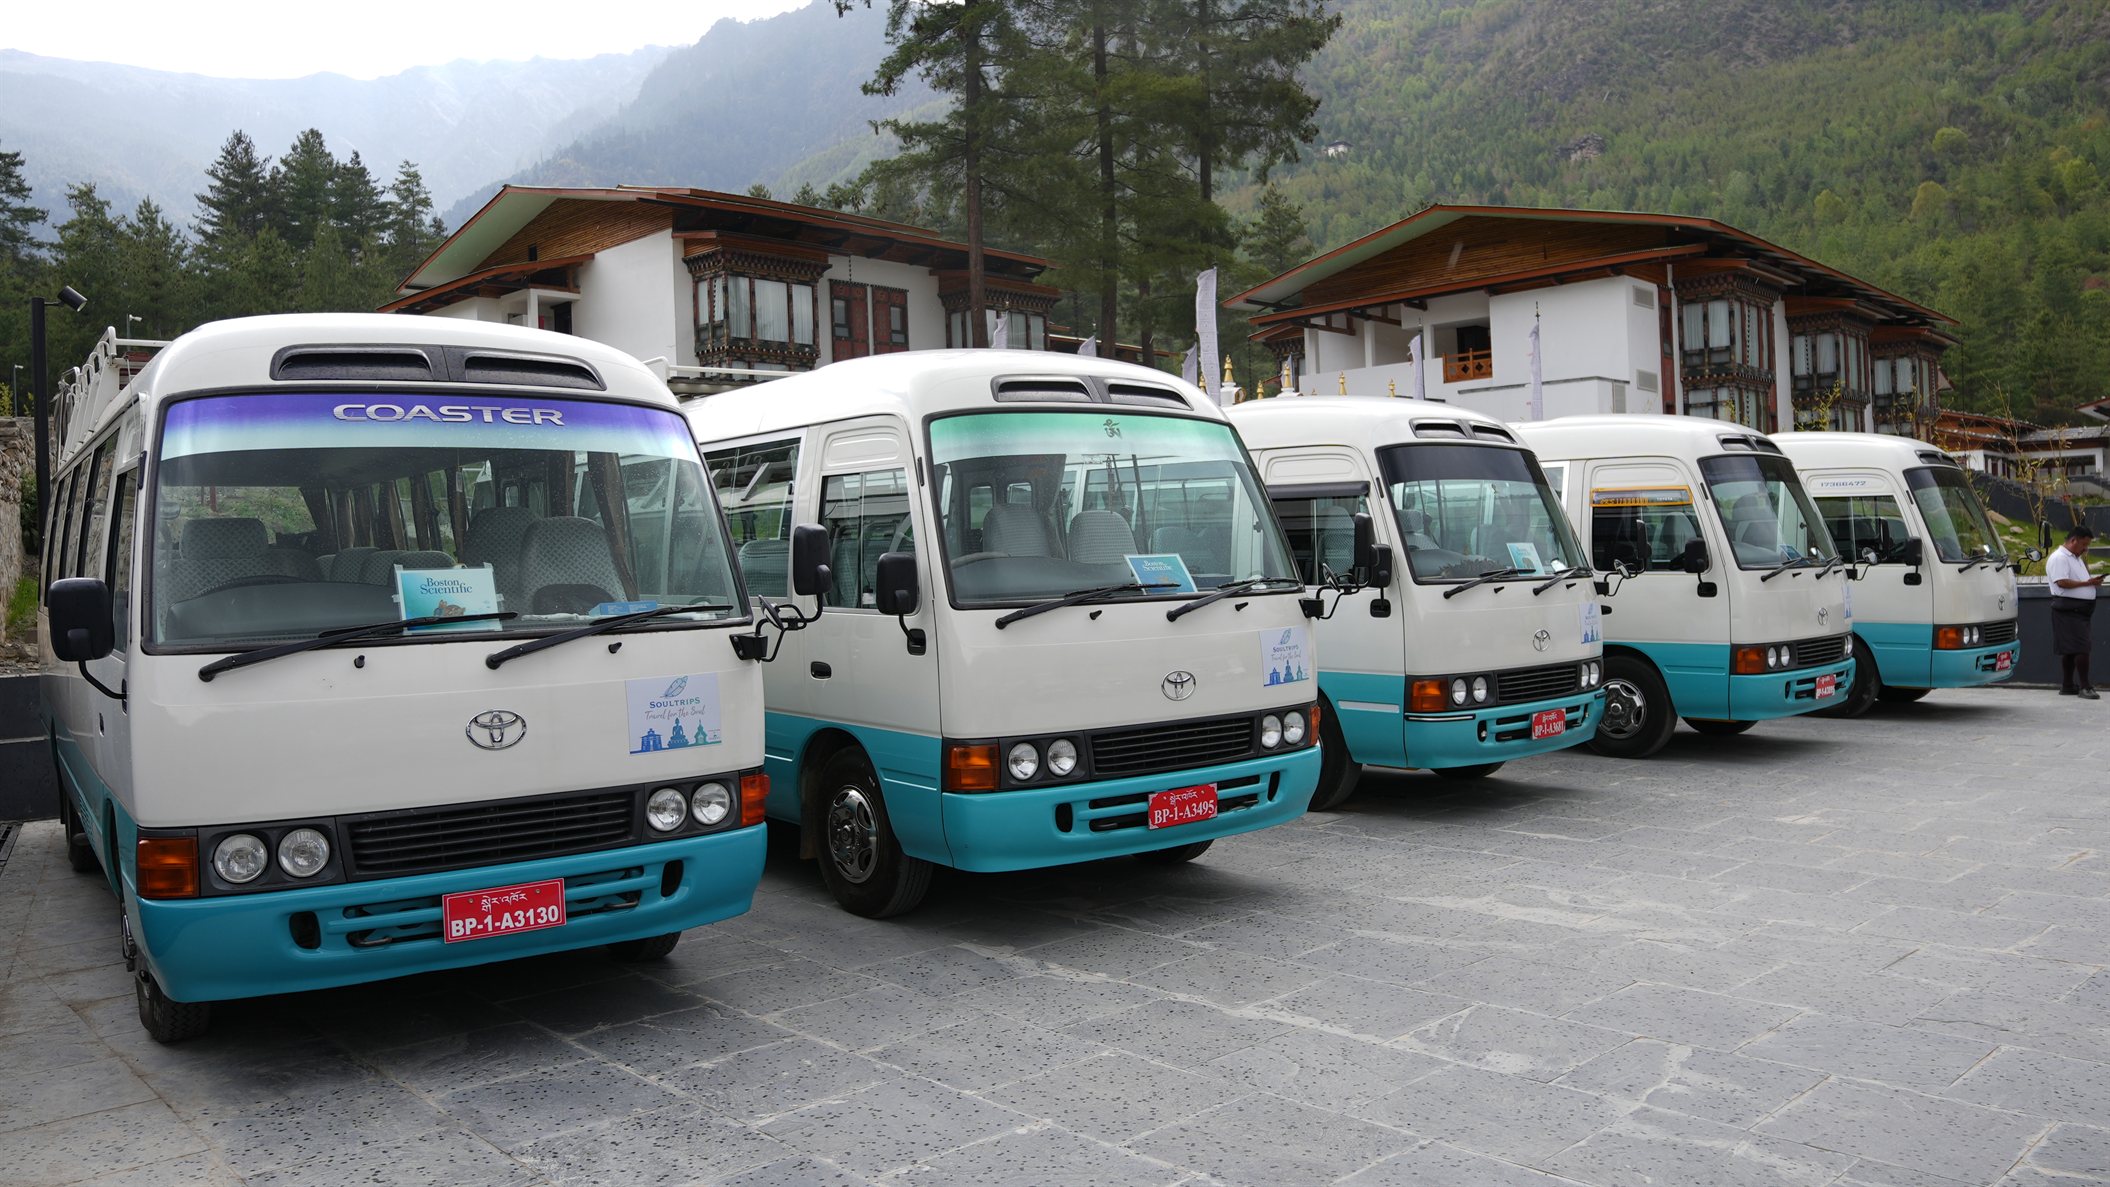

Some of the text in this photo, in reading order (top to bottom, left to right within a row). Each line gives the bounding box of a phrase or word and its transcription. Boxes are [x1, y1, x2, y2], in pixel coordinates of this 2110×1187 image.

[333, 404, 565, 426] COASTER
[420, 583, 473, 595] Scientific
[426, 577, 460, 587] Boston
[649, 697, 701, 709] SOULTRIPS
[644, 704, 706, 720] Travel for the Soul
[1154, 799, 1215, 824] BP-1-A3495
[451, 905, 559, 937] BP-1-A3130
